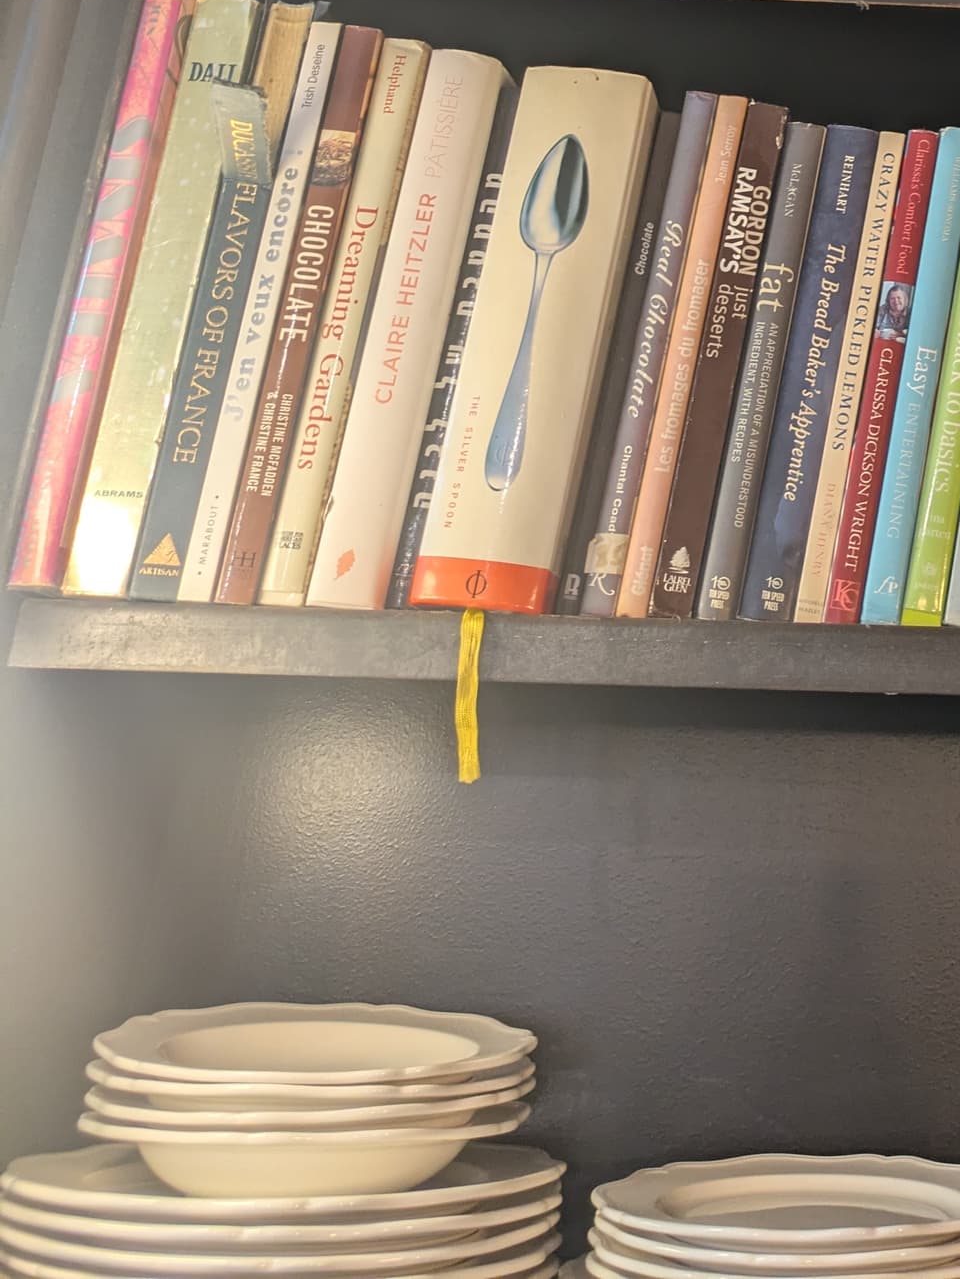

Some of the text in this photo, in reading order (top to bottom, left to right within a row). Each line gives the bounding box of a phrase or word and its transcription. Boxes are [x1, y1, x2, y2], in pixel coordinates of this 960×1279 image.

[720, 166, 758, 274] RAMSAY'S
[742, 185, 772, 277] GORDON
[836, 155, 855, 214] REINHART
[173, 182, 259, 464] FLAVORS OF FRANCE
[279, 204, 334, 342] CHOCOLATE
[298, 207, 379, 470] Dreaming Gardens
[375, 316, 410, 404] CLAIRE
[396, 193, 437, 306] HEITZLER
[706, 283, 732, 359] desserts
[756, 262, 794, 313] fat
[832, 153, 895, 451] CRAZY WATER PICKLED LEMONS
[783, 244, 847, 502] The Bread Baker's Apprentice
[94, 490, 144, 499] ABRAMS
[246, 403, 276, 492] CHRISTINE FRANCE
[444, 395, 480, 528] THE SILVER SPOON
[846, 348, 893, 572] CLARISSA DICKSON WRIGHT
